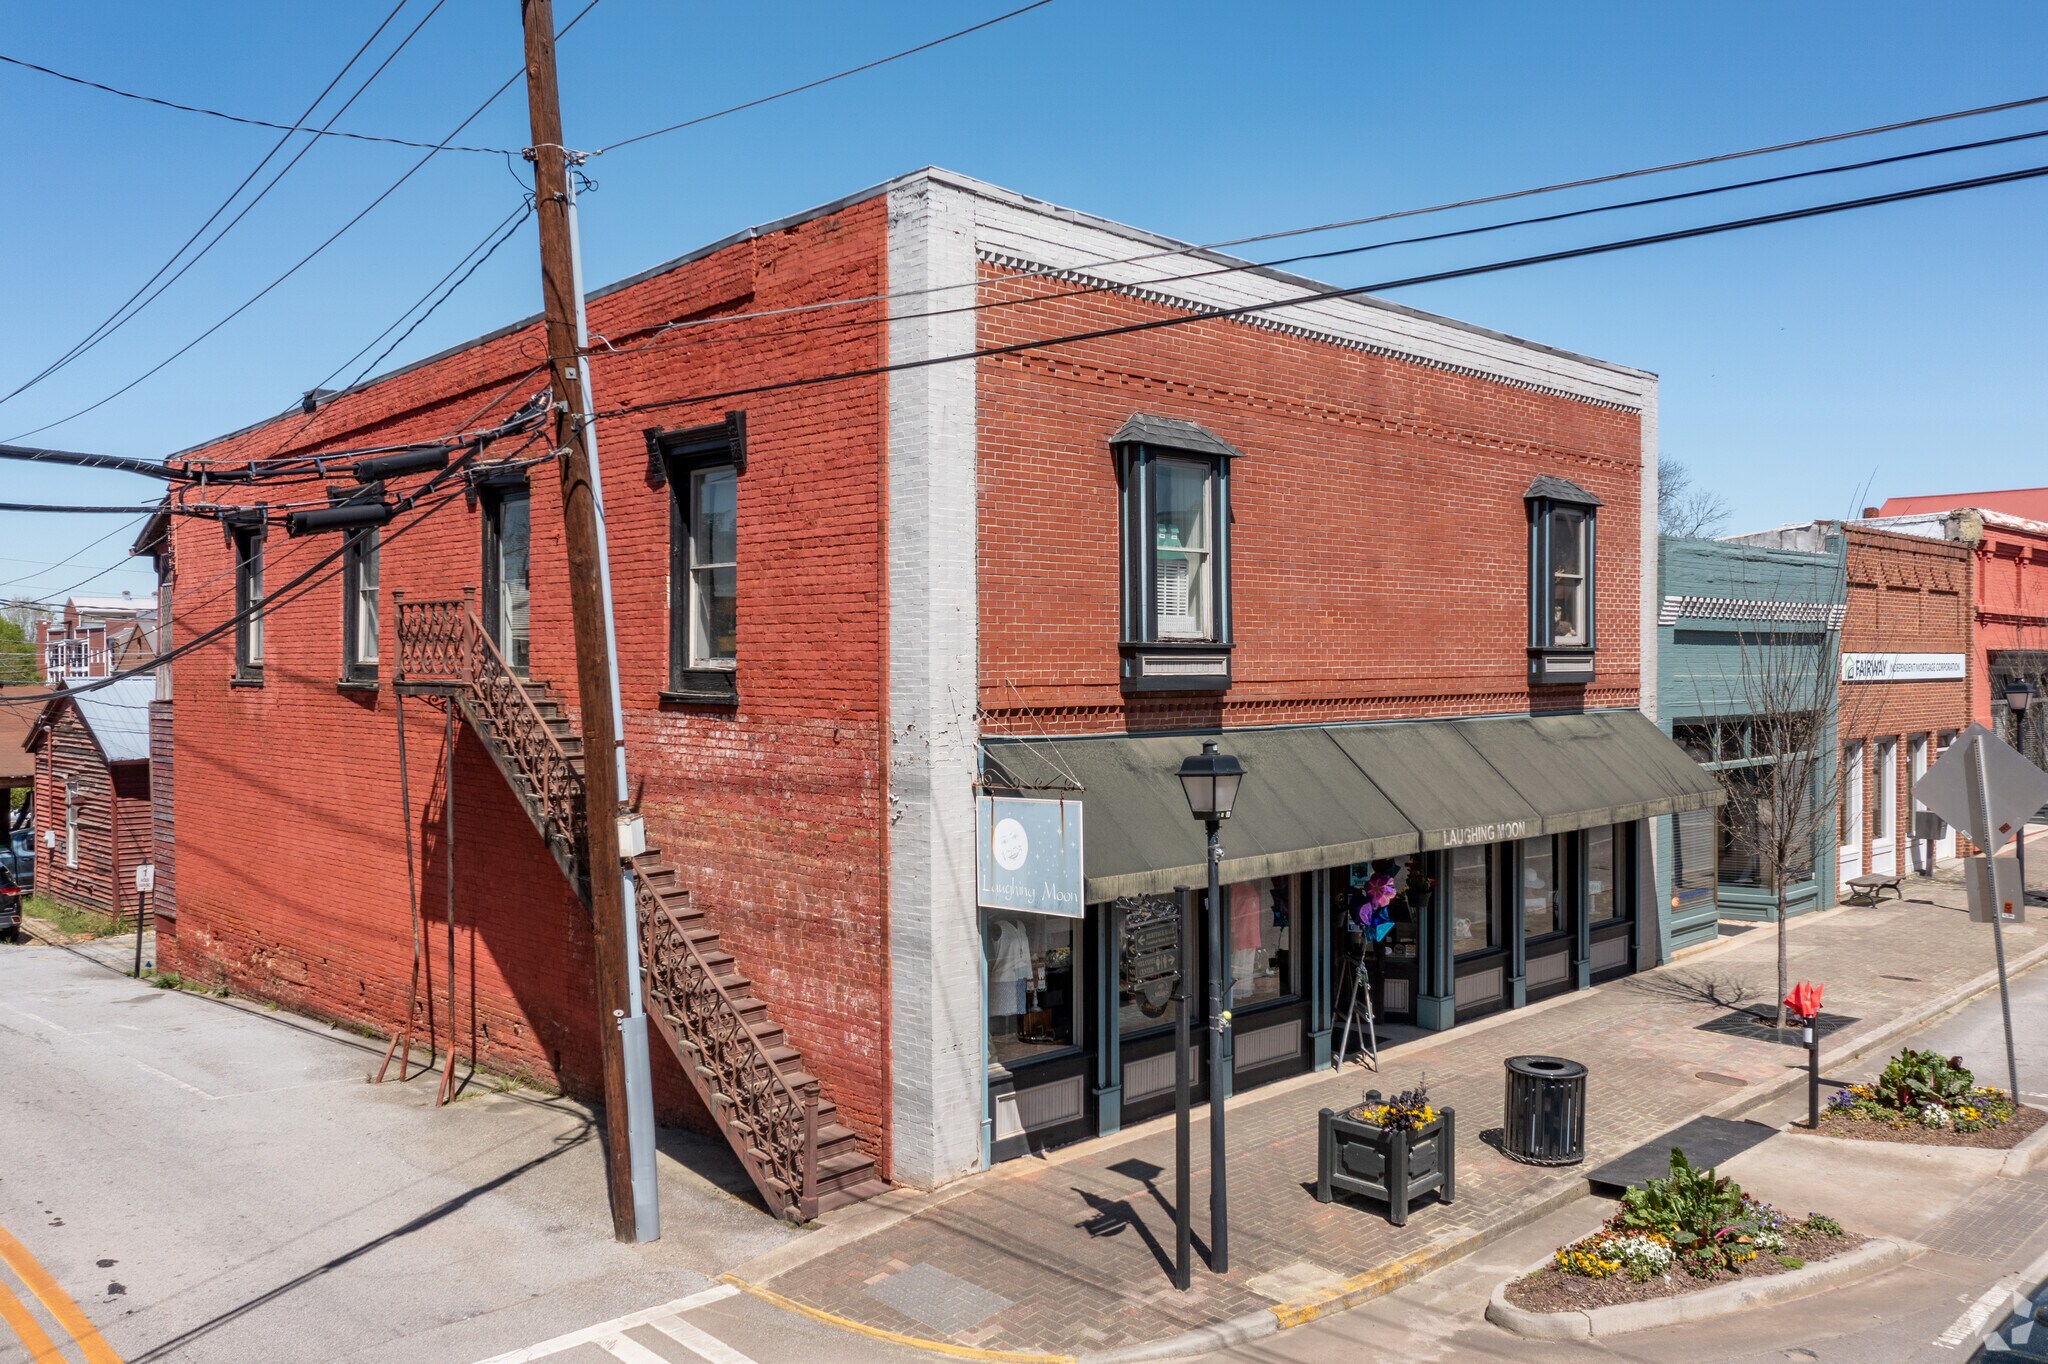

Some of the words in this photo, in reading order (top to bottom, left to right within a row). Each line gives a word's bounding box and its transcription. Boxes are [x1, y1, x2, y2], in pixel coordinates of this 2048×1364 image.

[1855, 660, 1888, 676] FAIRWAY
[1890, 663, 1916, 672] INDEPENDENT
[1916, 663, 1936, 671] MORTGAGE
[1936, 663, 1960, 671] CORPORATION
[1443, 825, 1494, 845] LAUGHING
[1497, 821, 1526, 839] MOON
[982, 874, 1036, 903] Laughing
[1042, 881, 1078, 903] Moon
